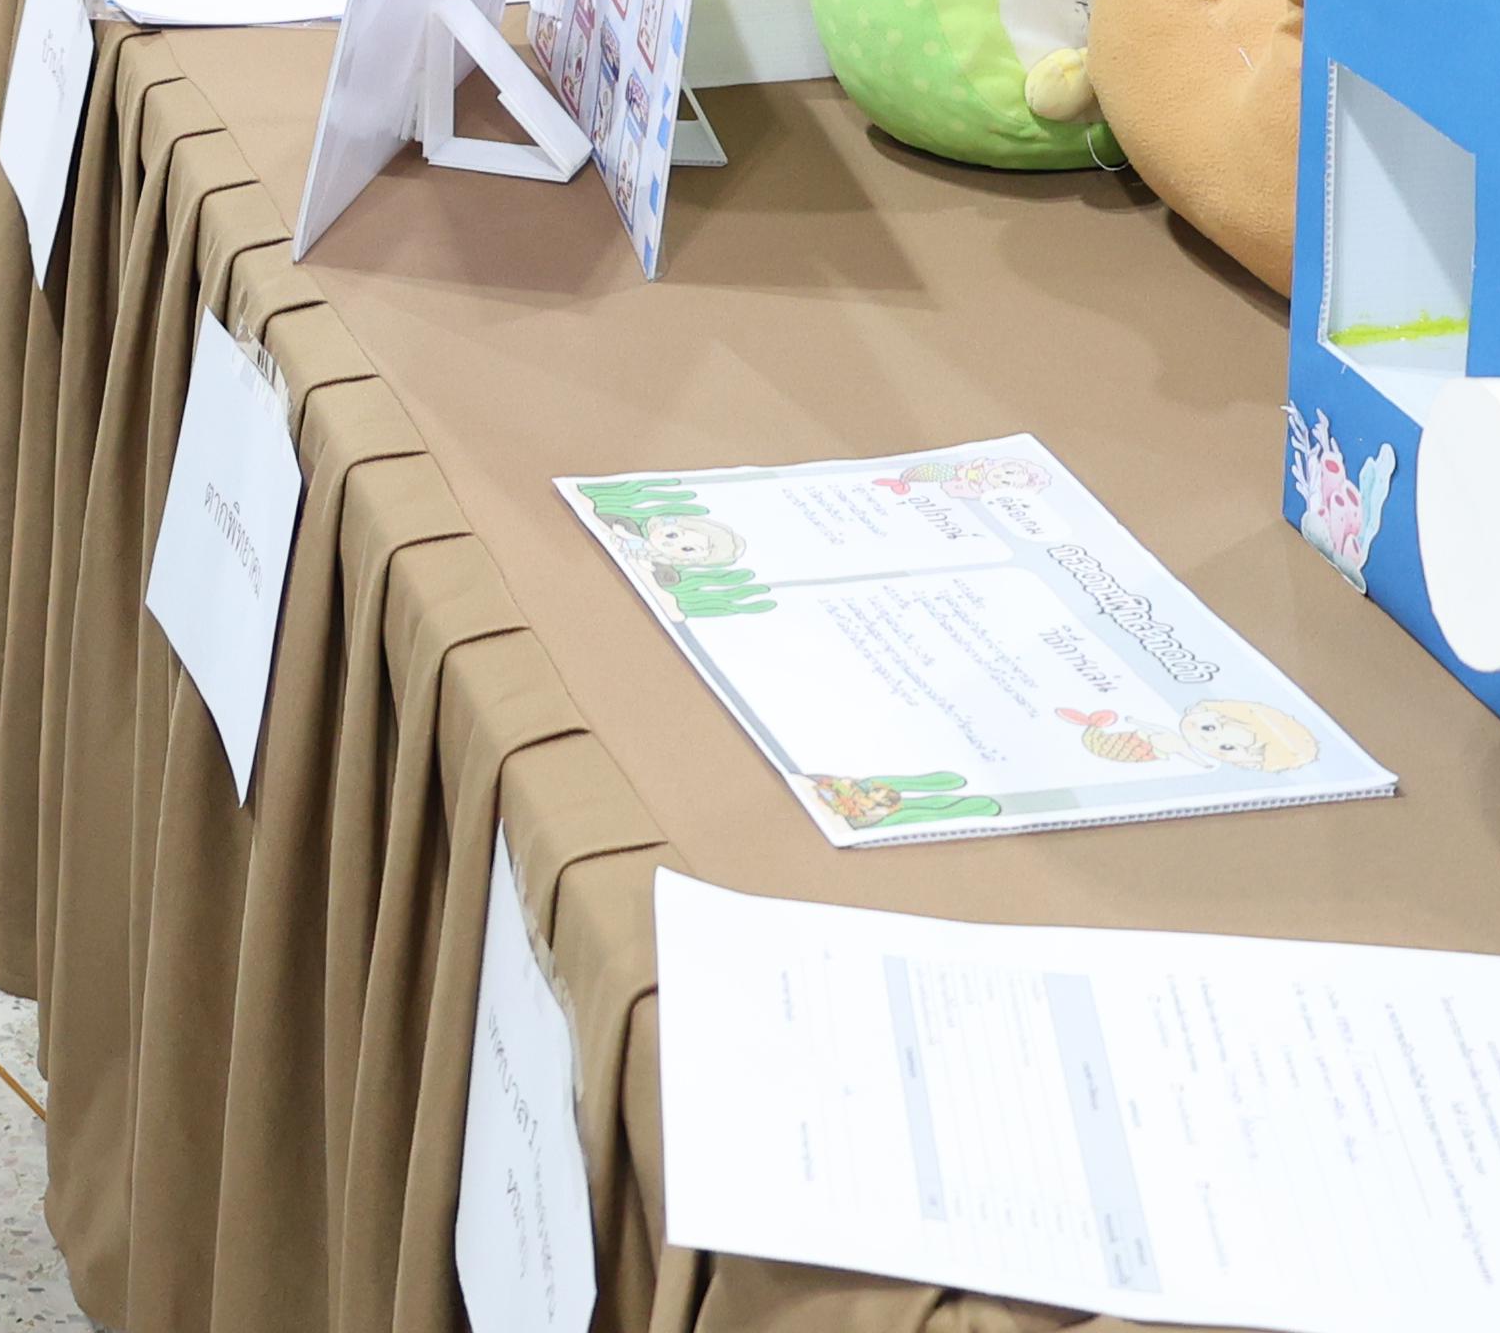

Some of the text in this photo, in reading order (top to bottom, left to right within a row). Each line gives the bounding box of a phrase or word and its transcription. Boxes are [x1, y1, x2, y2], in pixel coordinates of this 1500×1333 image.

[892, 492, 986, 544] อุปกรณ์
[1046, 542, 1222, 687] กระดานฝึกสะกดคำ
[1039, 624, 1119, 694] วิธีการเล่น
